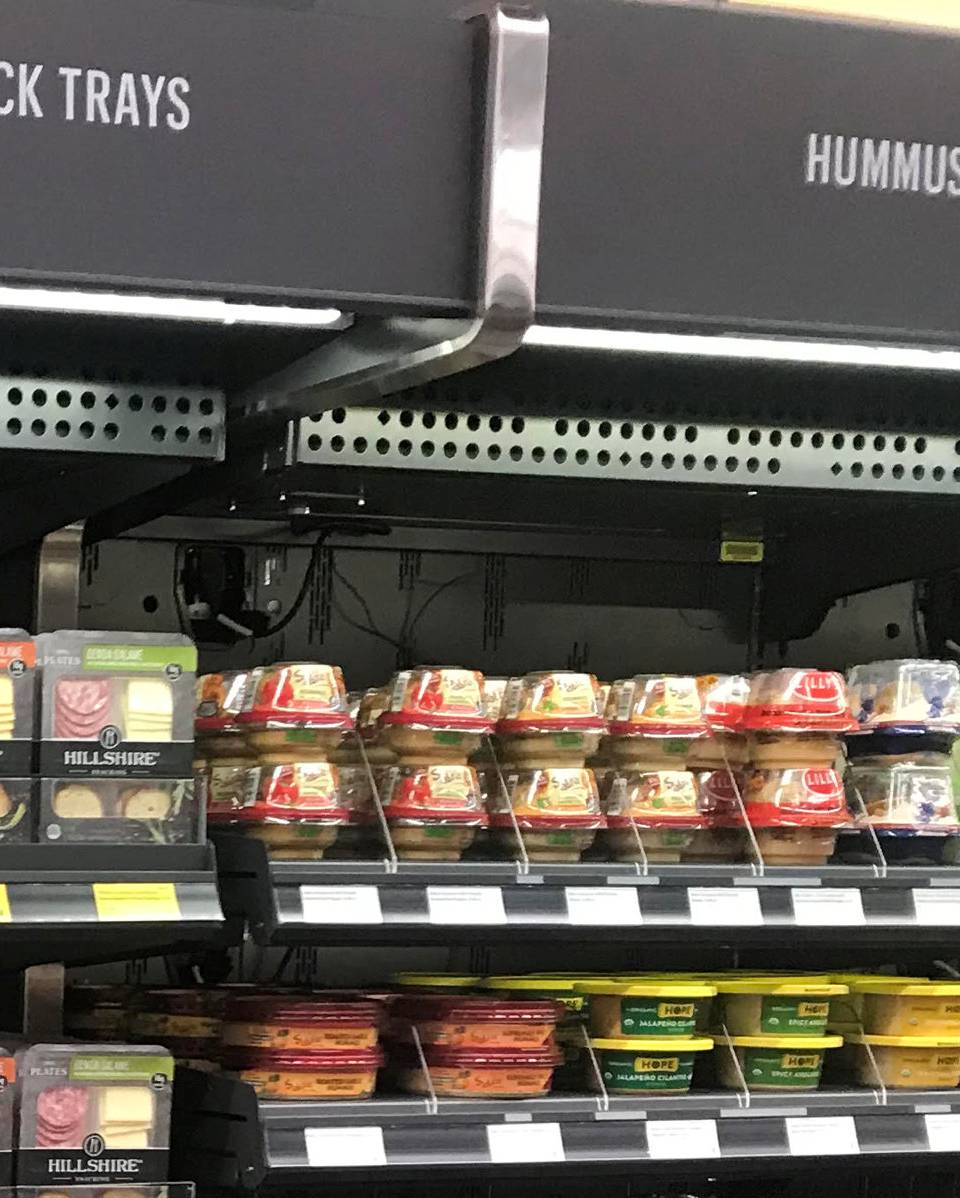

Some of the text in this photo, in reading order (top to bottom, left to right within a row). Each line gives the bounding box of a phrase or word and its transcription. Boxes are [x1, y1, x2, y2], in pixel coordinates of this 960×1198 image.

[58, 65, 191, 131] TRAYS
[806, 132, 960, 195] HUMMUS
[63, 751, 158, 766] HILLSHIRE
[664, 1004, 692, 1015] HOPE
[641, 1059, 675, 1069] HOPE
[48, 1159, 140, 1173] HILLSHIRE
